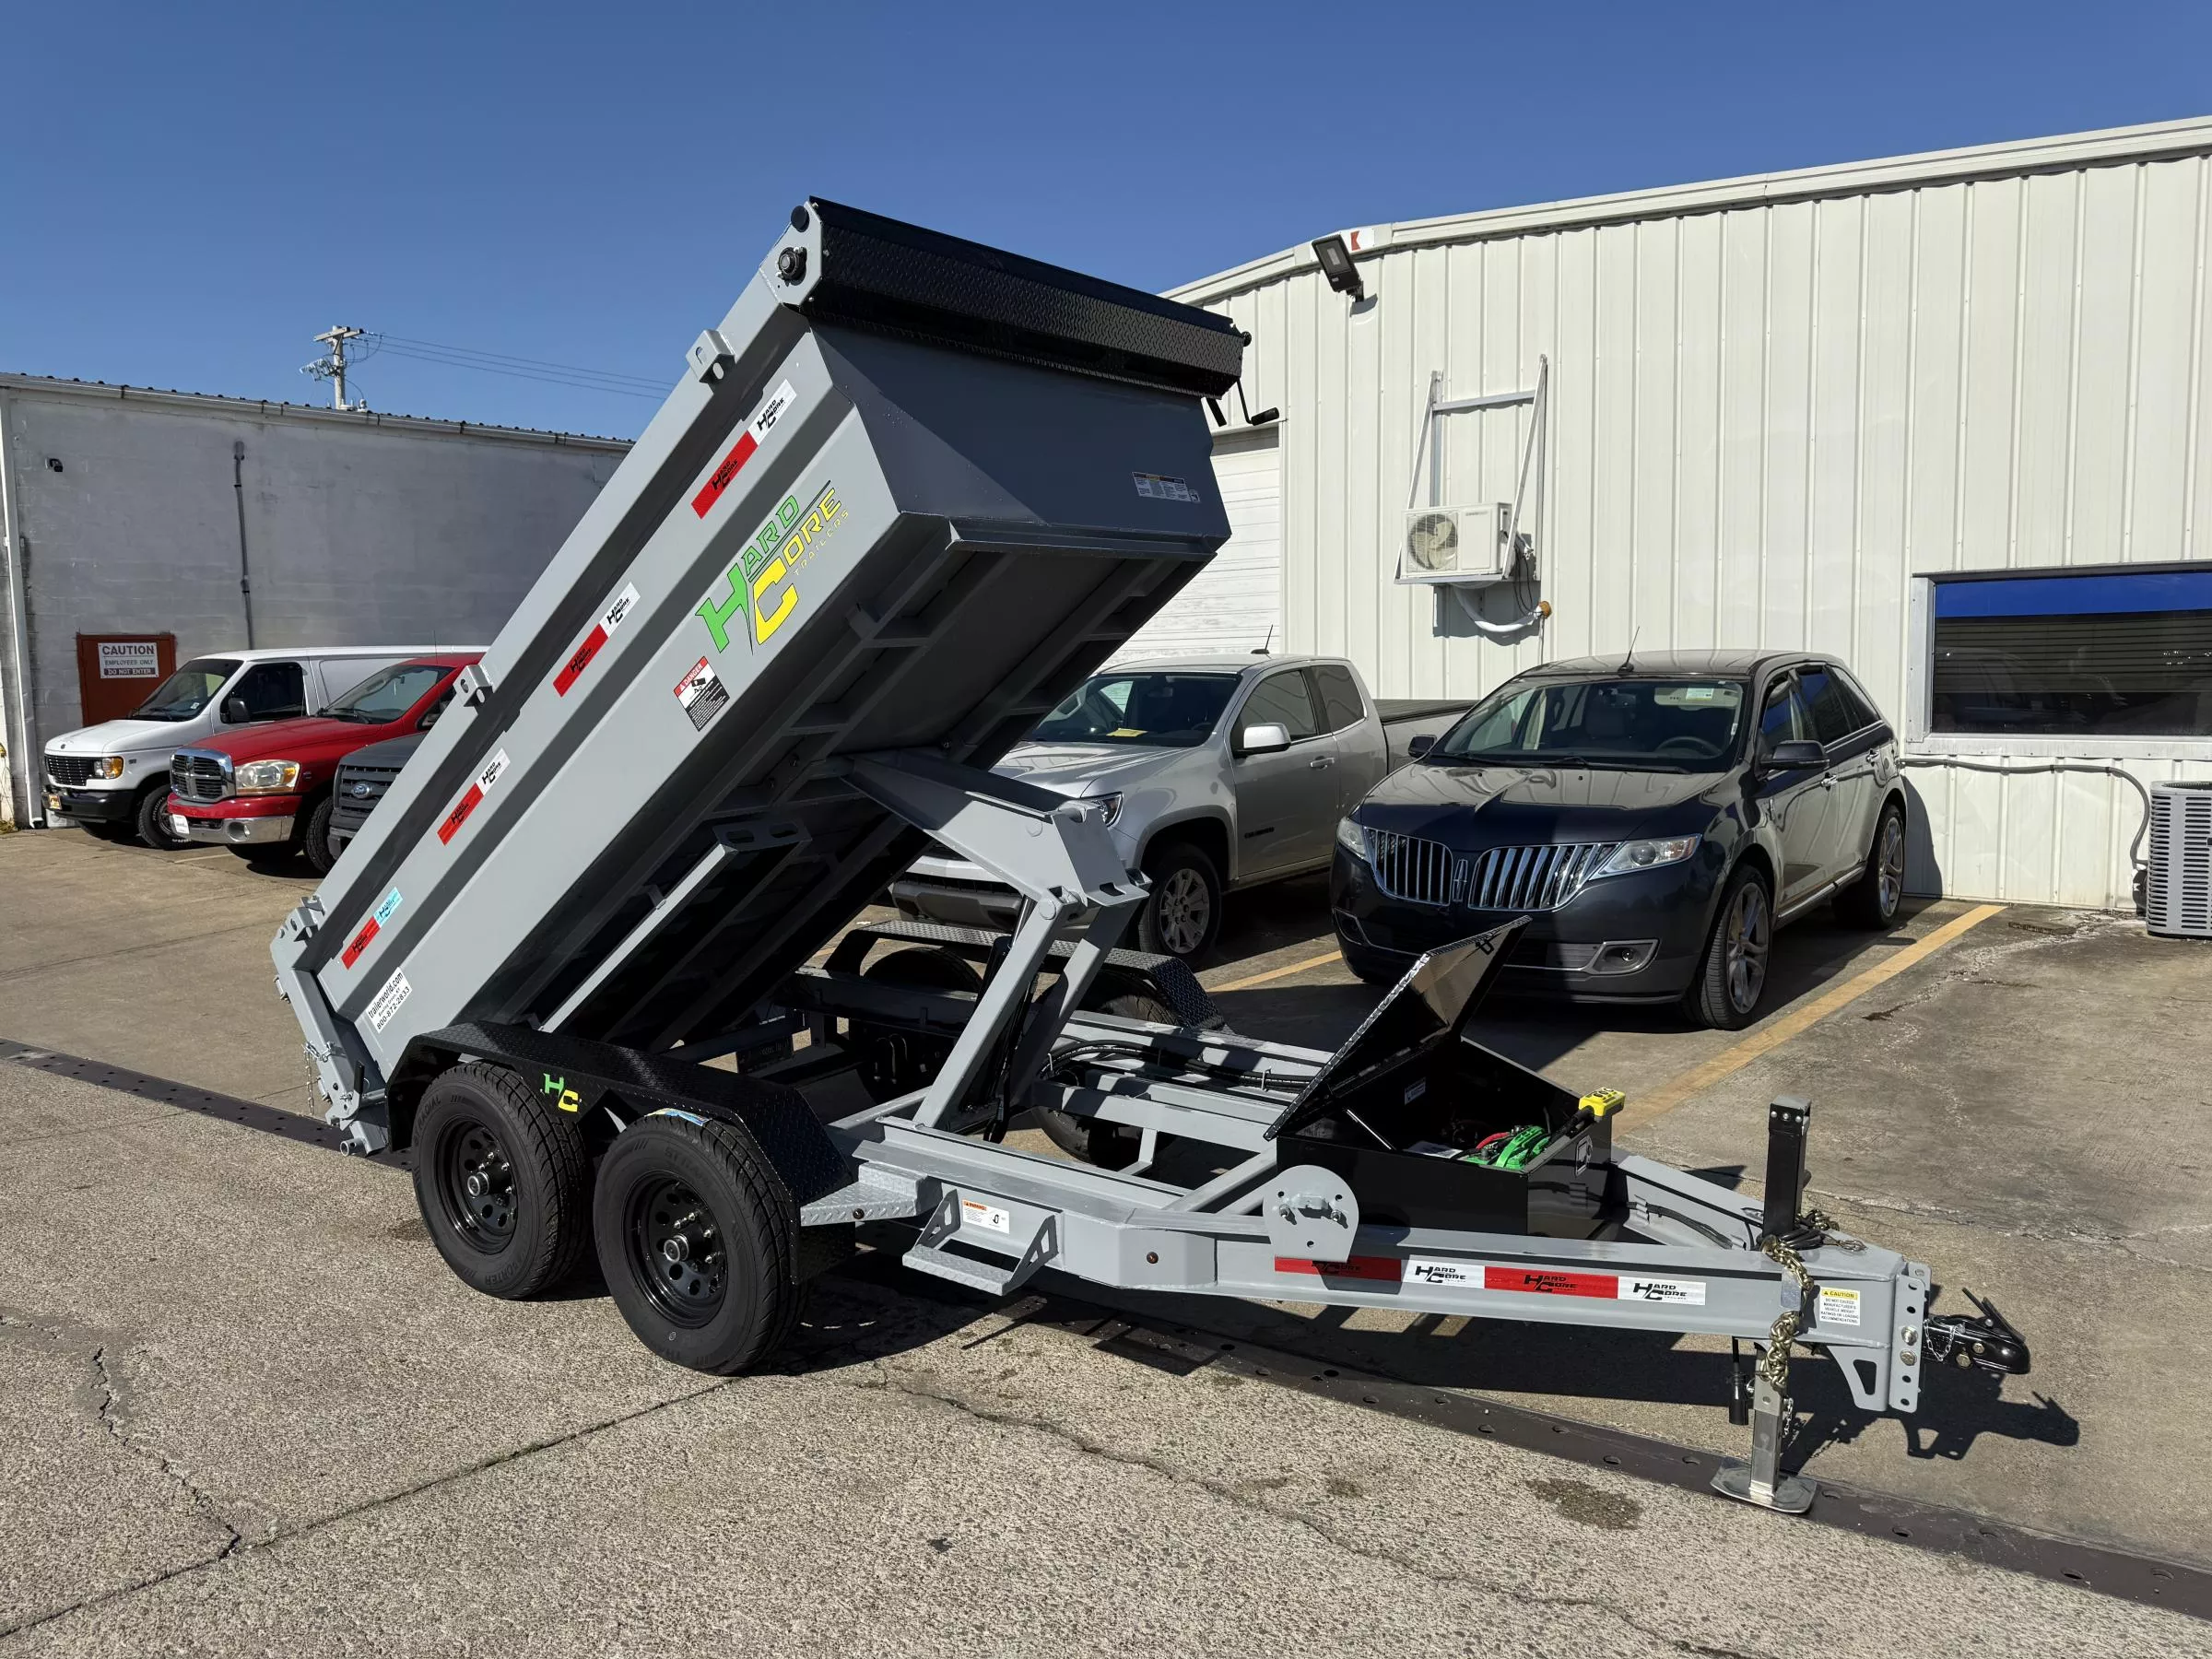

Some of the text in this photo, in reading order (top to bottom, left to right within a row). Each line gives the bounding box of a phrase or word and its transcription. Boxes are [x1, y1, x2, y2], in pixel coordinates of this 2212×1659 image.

[757, 399, 777, 431] HARD
[767, 397, 784, 429] CORE
[794, 509, 849, 576] TRAILERS
[695, 495, 800, 654] HARD
[753, 488, 841, 645] CORE
[102, 645, 154, 654] CAUTION
[684, 664, 702, 686] DANGER
[369, 972, 404, 1018] trailerworld.com
[543, 1073, 579, 1112] HC
[1415, 1265, 1456, 1278] HARD
[1426, 1273, 1466, 1284] CORE
[1524, 1274, 1567, 1287] HARD
[1535, 1281, 1578, 1293] CORE
[1632, 1282, 1677, 1295] HARD
[1645, 1289, 1688, 1300] CORE
